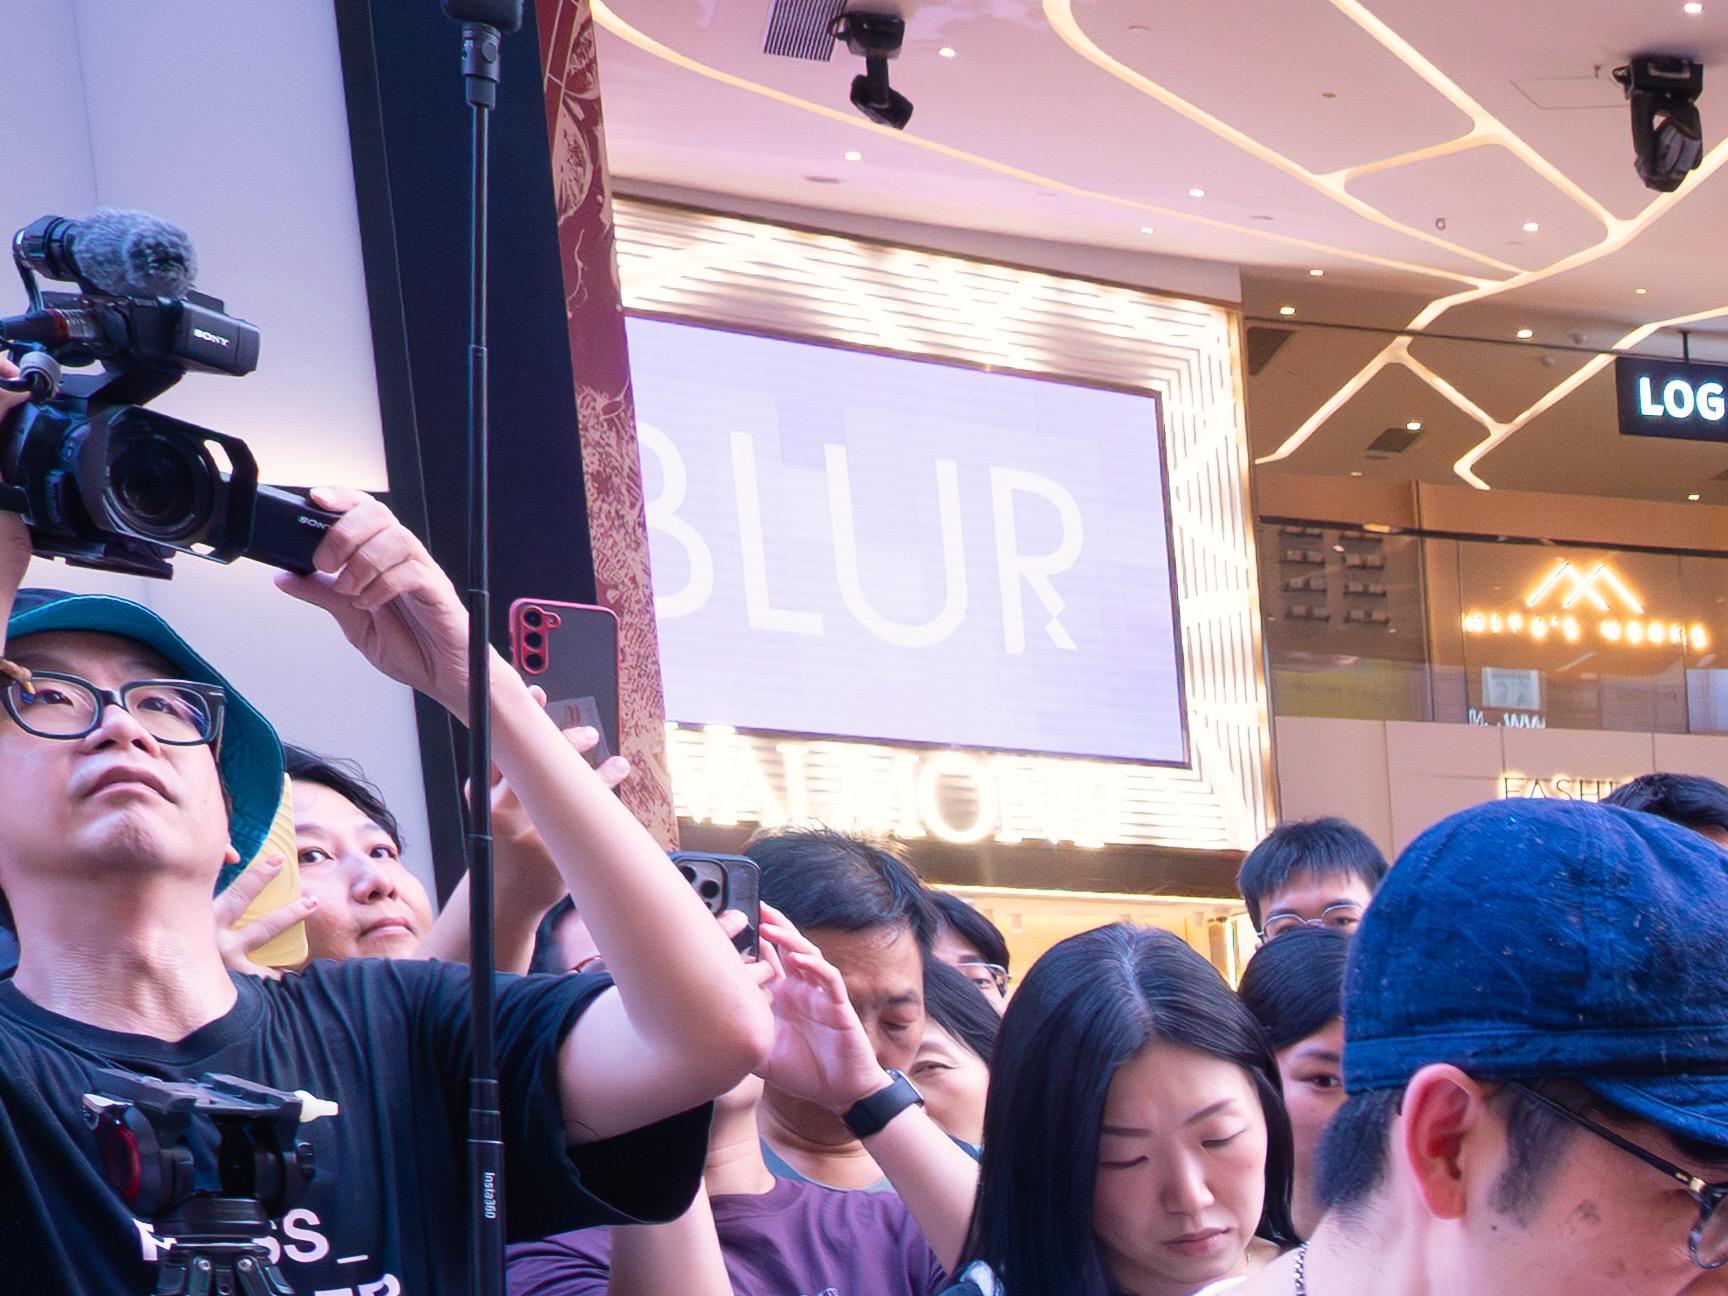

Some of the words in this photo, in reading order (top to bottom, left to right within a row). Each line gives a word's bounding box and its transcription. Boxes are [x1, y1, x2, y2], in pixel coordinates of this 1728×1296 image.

[193, 328, 230, 347] SONY
[299, 516, 330, 529] SON
[635, 418, 1085, 656] BLUR
[483, 1171, 497, 1219] Insta360
